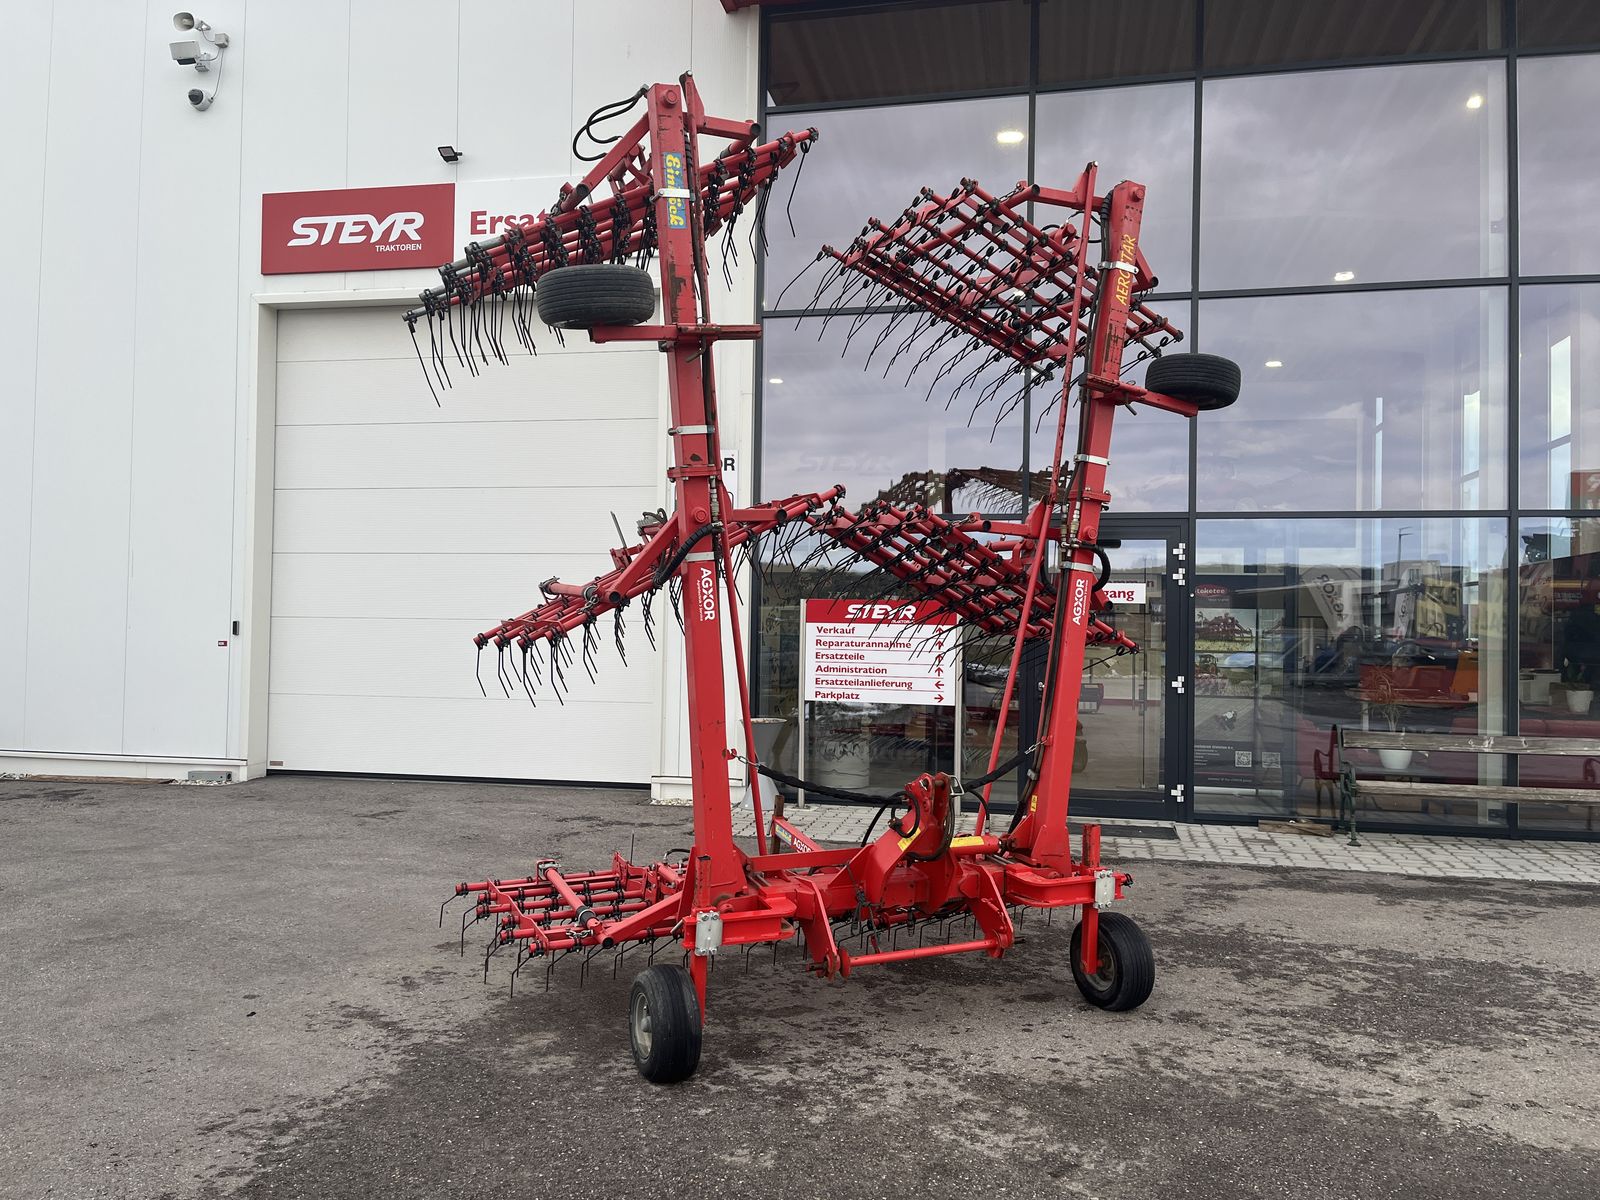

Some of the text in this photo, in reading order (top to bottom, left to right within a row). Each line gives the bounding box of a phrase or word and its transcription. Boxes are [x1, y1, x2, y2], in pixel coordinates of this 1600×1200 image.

[666, 154, 685, 226] Einöck
[287, 211, 425, 247] STEYR
[375, 243, 422, 252] TRAKTOREN
[1116, 234, 1136, 306] AEROTAR
[700, 567, 715, 621] AGXOR
[1072, 579, 1085, 625] AGXOR
[845, 604, 917, 619] STEYR
[816, 626, 856, 634] Verkauf
[815, 639, 912, 649] Reparaturannahme
[815, 652, 865, 661] Ersatzteile
[815, 665, 887, 674] Administration
[815, 677, 913, 690] Ersatzteilanlieferung
[815, 691, 860, 701] Parkplatz
